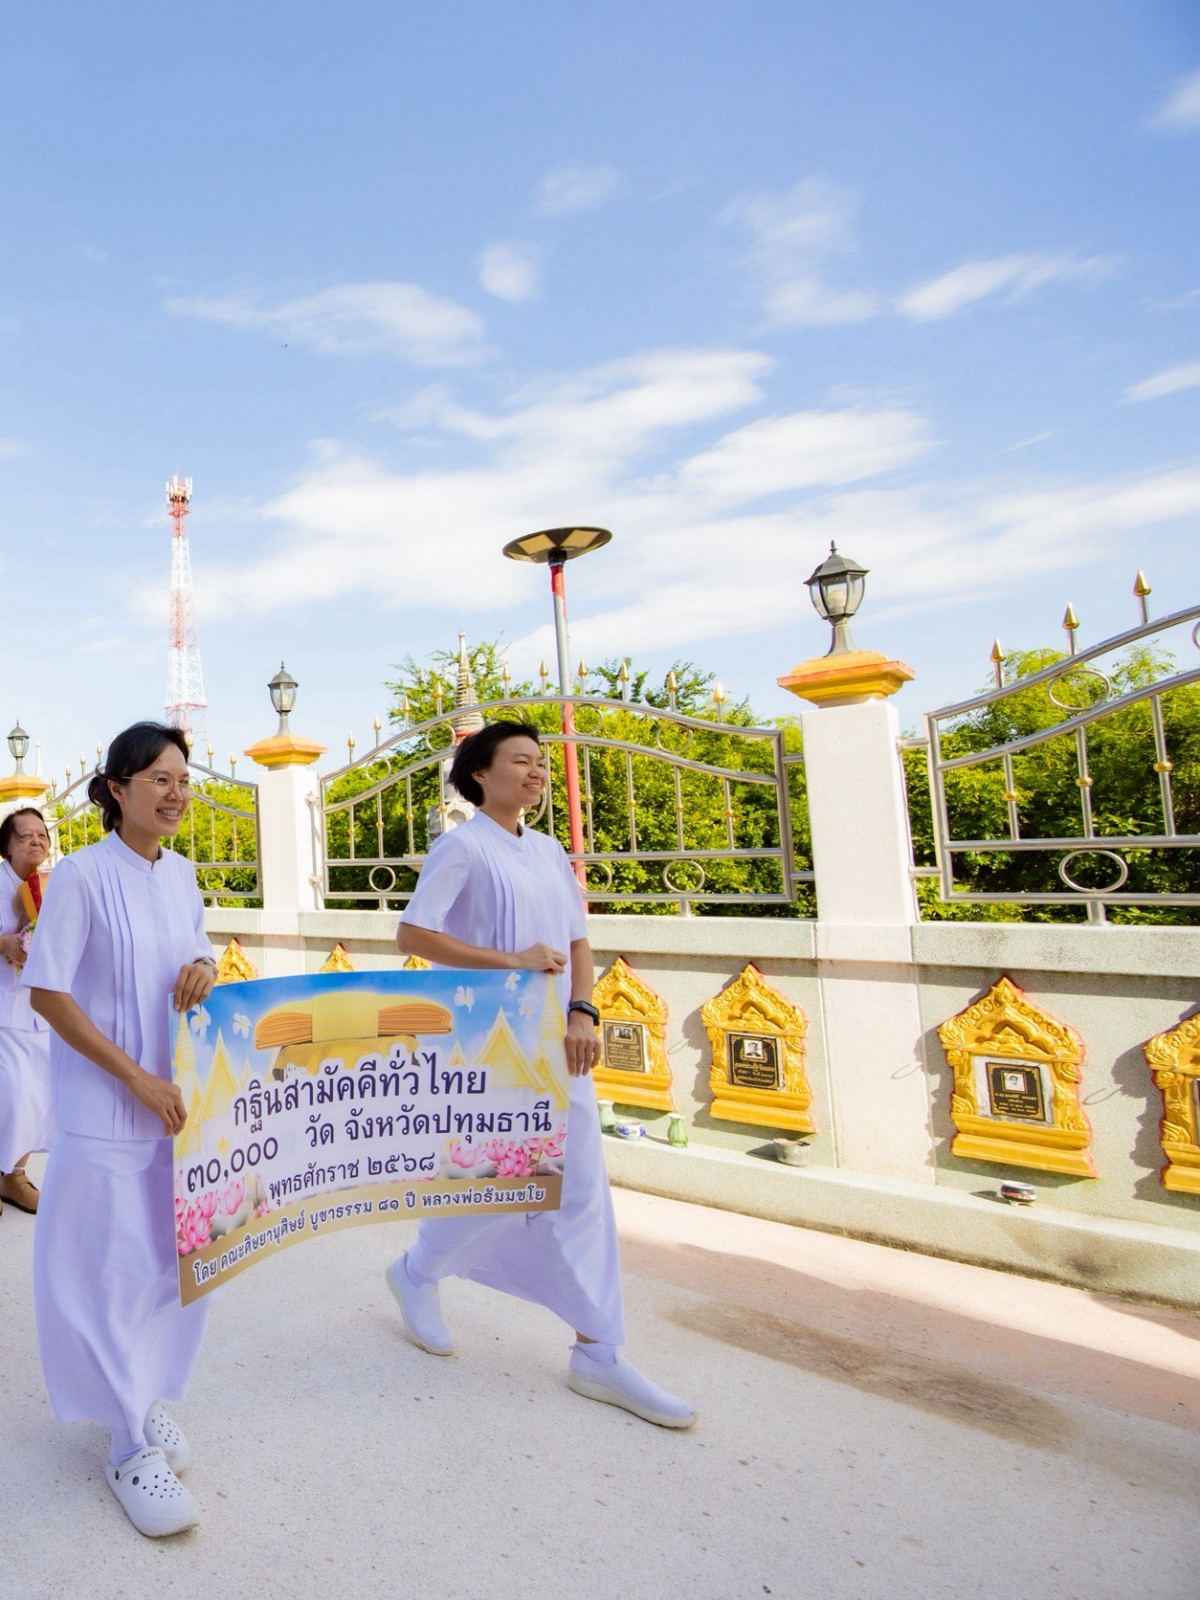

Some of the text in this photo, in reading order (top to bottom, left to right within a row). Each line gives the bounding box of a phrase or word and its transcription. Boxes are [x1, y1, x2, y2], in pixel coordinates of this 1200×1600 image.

[233, 1050, 487, 1134] กฐินสามัคคีทั่วไทย
[187, 1100, 552, 1193] ๓๐,๐๐๐ วัด จังหวัดปทุมธานี
[269, 1152, 436, 1206] พุทธศักราช ๒๕๖๘
[194, 1186, 545, 1284] โดย คณะศิษยานุศิษย์ บูชาธรรม ๘๑ ปี หลวงพ่อธัมมชโย
